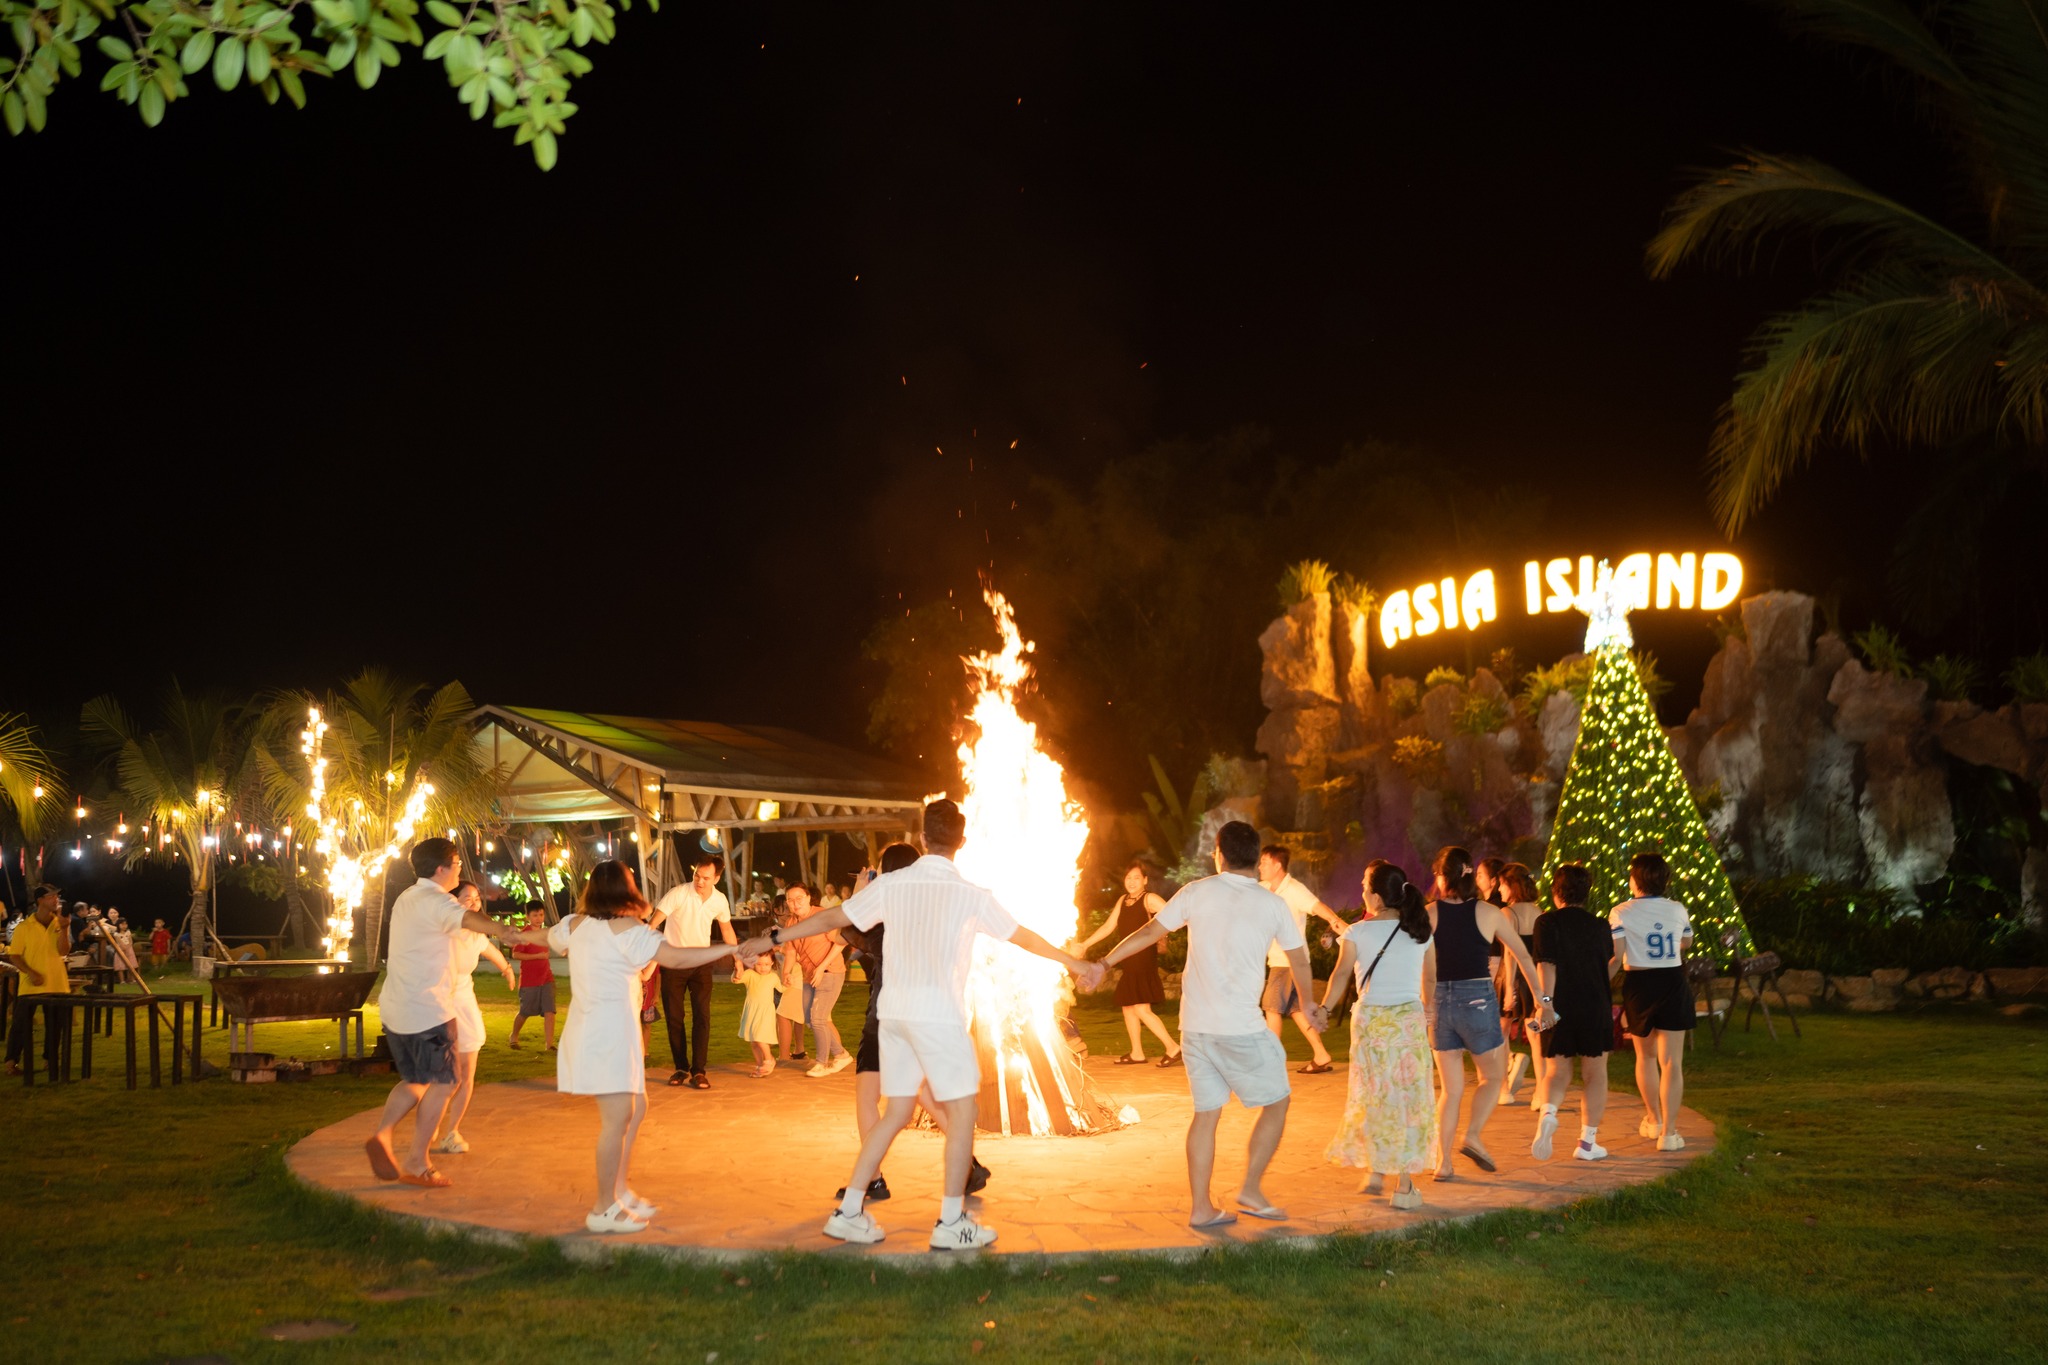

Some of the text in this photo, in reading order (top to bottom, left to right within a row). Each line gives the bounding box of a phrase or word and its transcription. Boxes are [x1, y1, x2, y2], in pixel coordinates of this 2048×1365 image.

[1380, 552, 1744, 649] ASIA ISLAND
[1647, 933, 1676, 959] 91
